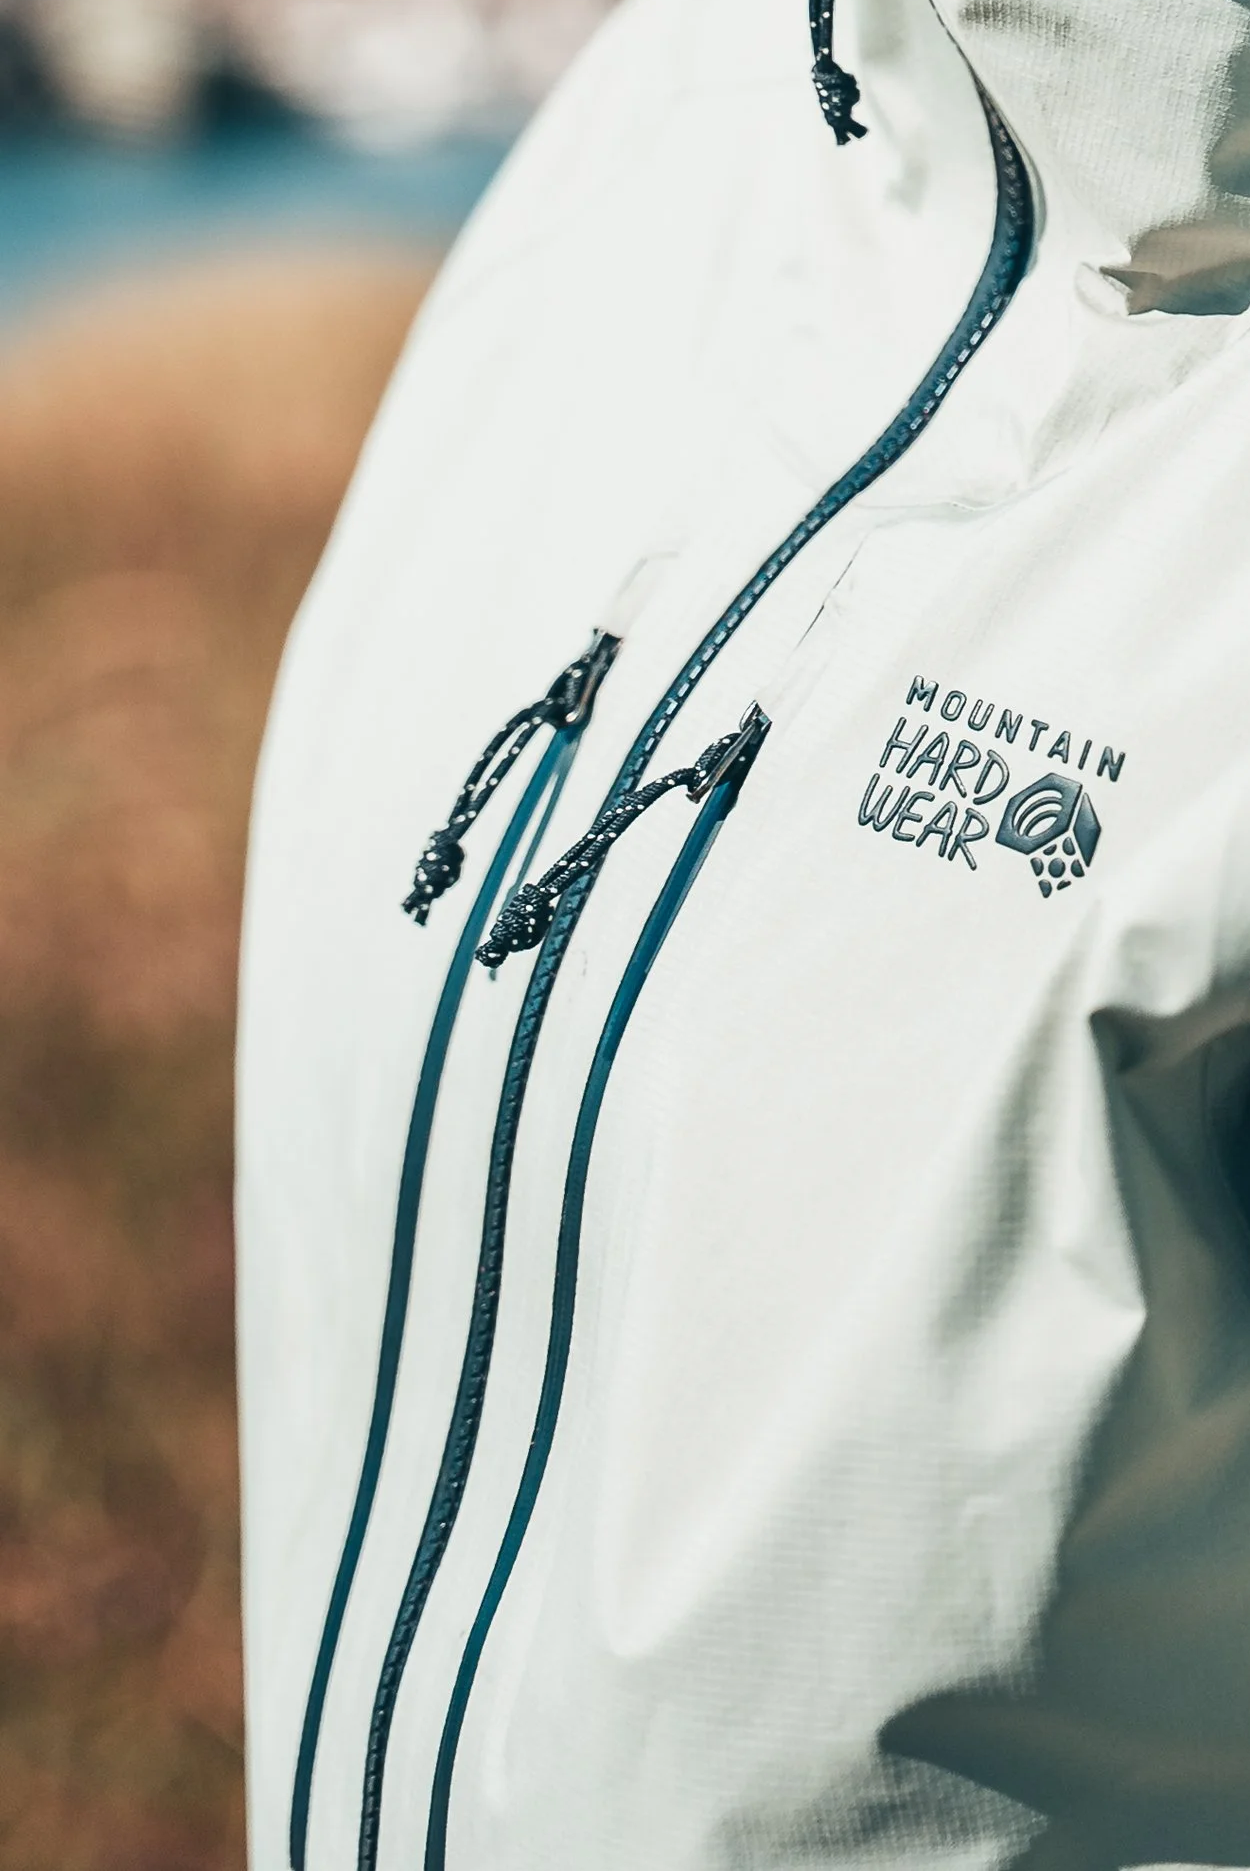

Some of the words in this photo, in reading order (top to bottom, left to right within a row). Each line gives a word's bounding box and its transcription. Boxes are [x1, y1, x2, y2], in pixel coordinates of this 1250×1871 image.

[879, 717, 1010, 805] HARD
[905, 675, 1125, 782] MOUNTAIN
[857, 773, 990, 871] WEAR
